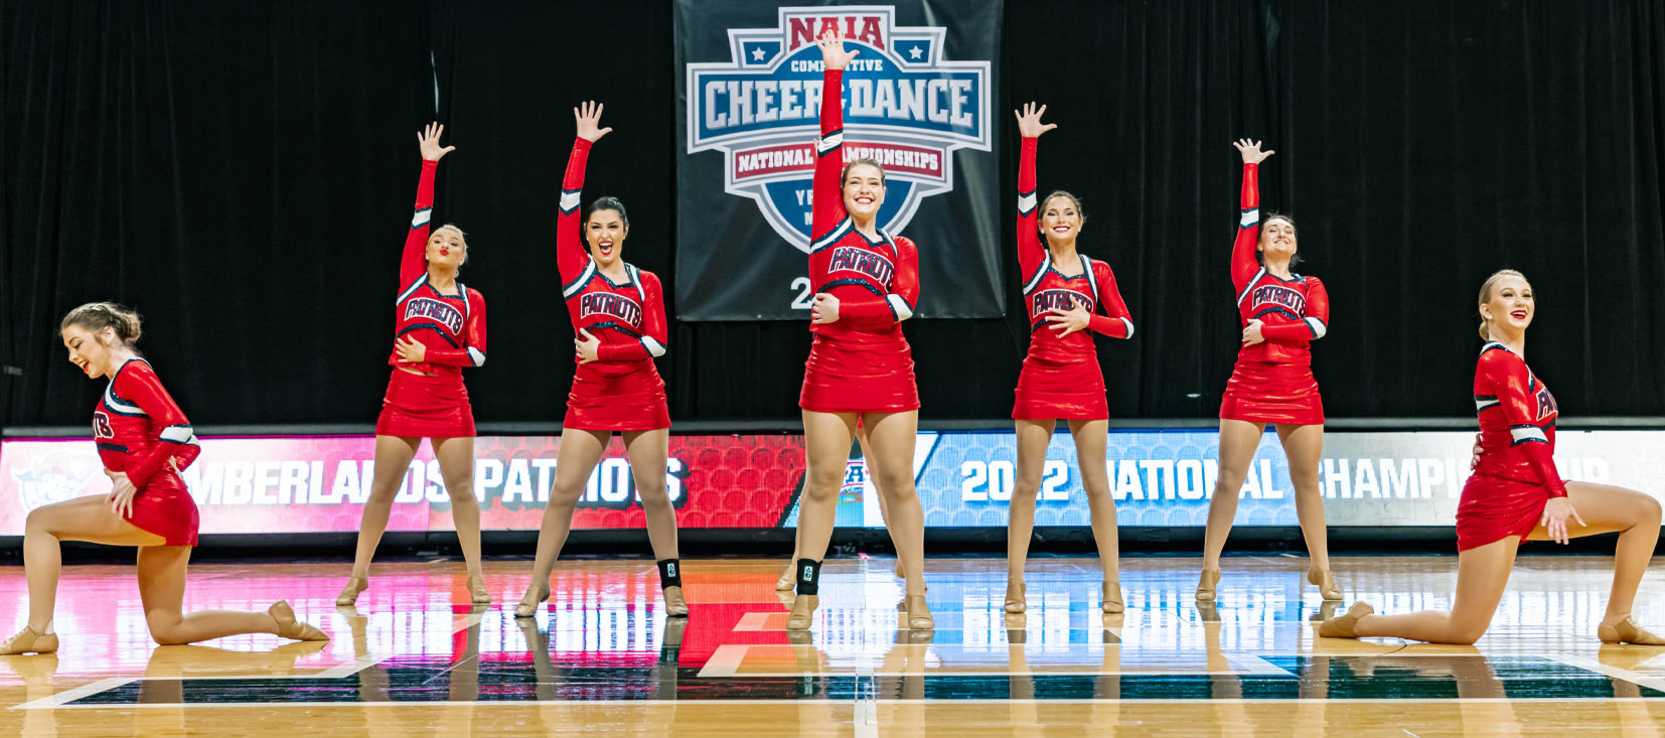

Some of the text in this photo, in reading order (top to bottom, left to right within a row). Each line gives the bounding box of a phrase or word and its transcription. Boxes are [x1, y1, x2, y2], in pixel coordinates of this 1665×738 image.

[789, 16, 885, 52] NAIA
[790, 59, 884, 73] COMPITIVE
[704, 80, 824, 130] CHEER
[848, 79, 973, 128] DANCE
[738, 146, 938, 173] NATIONAL MPIONSHIPS
[403, 297, 464, 336] PATRIOTS
[580, 291, 642, 329] PATRIOTS
[188, 457, 682, 505] MBERLADS PATIOS
[960, 459, 1070, 501] 202
[1105, 458, 1284, 501] ATIOAL
